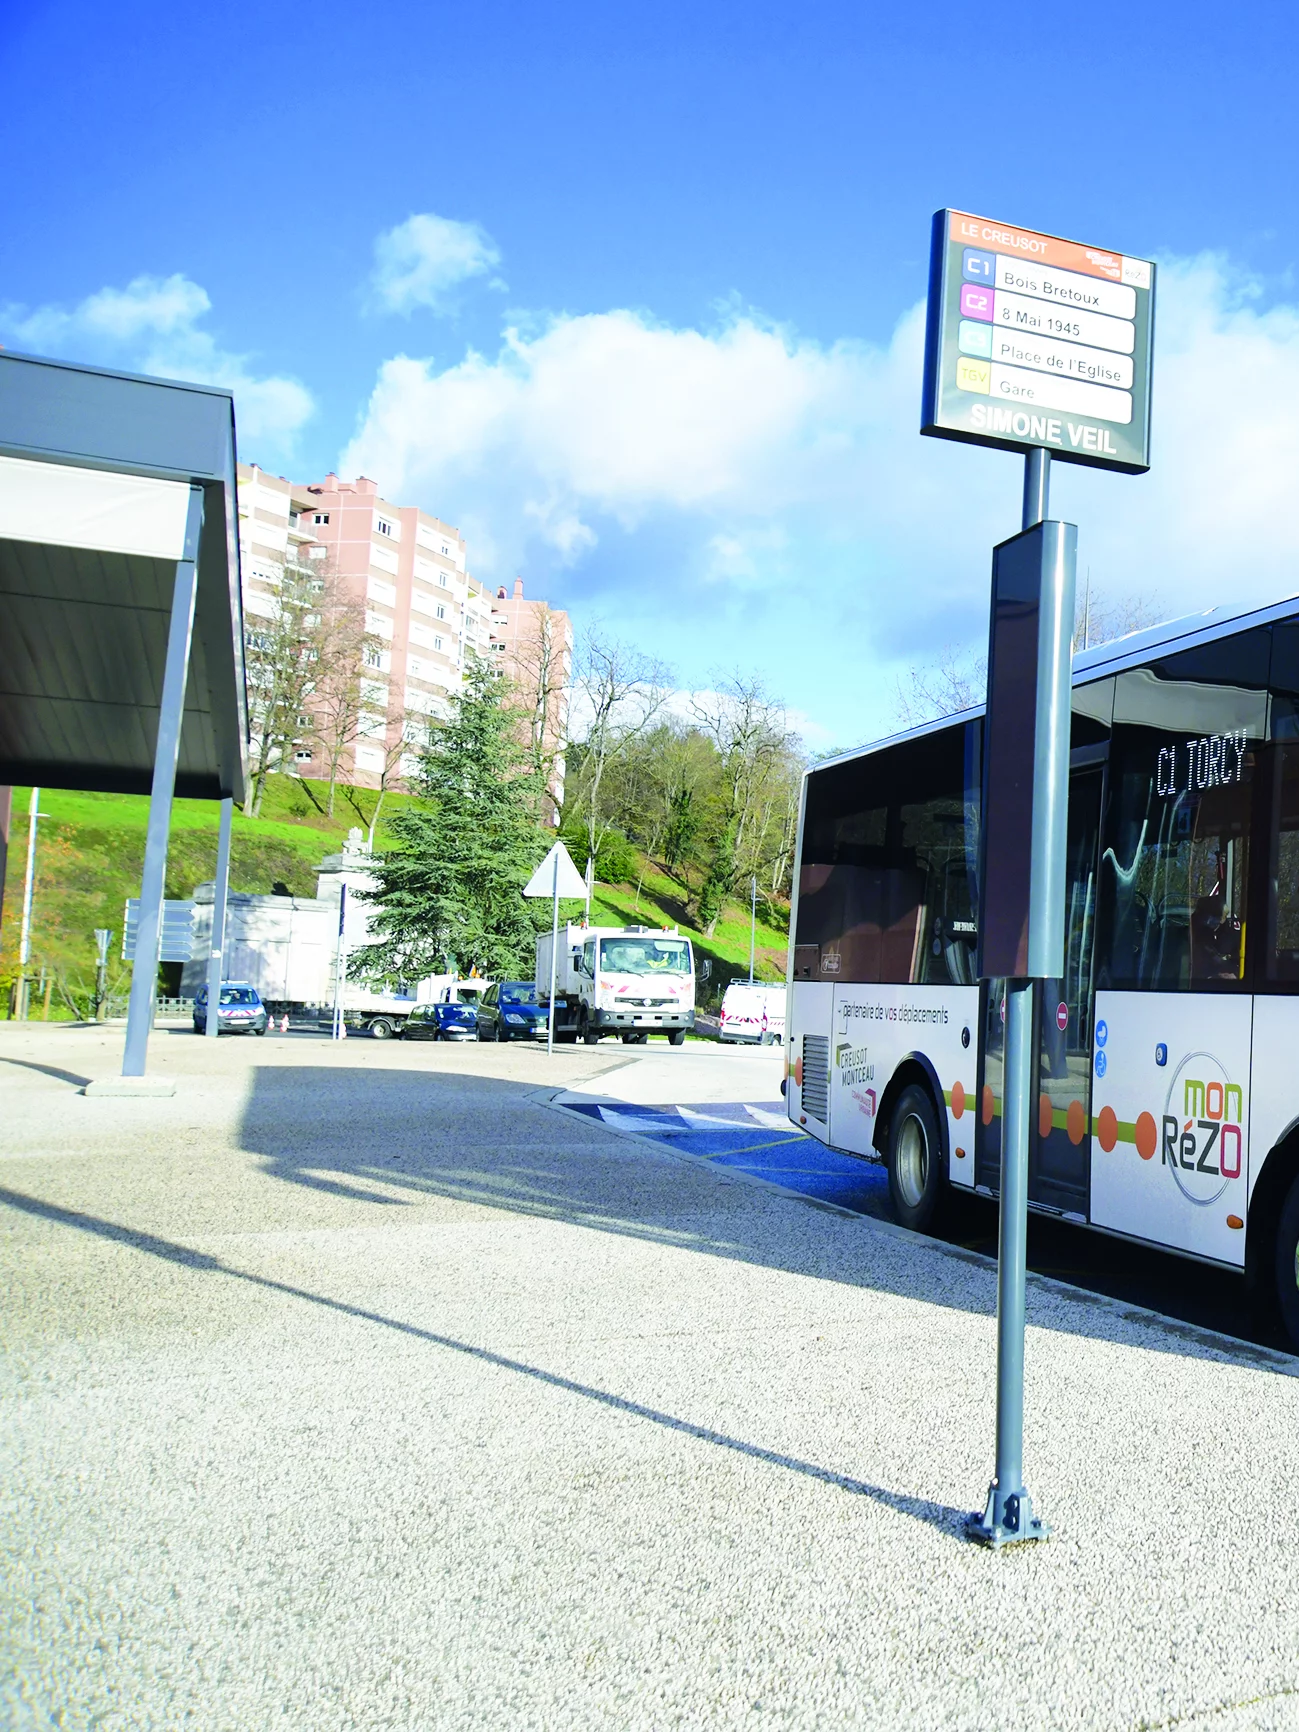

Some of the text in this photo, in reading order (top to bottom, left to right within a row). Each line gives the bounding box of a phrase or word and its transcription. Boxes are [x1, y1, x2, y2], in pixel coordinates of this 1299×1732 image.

[961, 222, 1048, 254] LE CREUSOT
[967, 257, 990, 276] C1
[1004, 272, 1100, 306] Bois Bretoux
[965, 293, 988, 312] C2
[1002, 307, 1080, 336] 8 Mai 1945
[1001, 343, 1042, 364] Place
[1046, 355, 1064, 369] de
[961, 367, 987, 383] TGV
[1000, 380, 1035, 399] Gare
[969, 403, 1117, 455] SIMONE VEIL
[1156, 728, 1247, 797] C1 TORCY
[843, 1002, 949, 1024] partenaire de vos déplacements
[840, 1047, 868, 1069] CREUSOT
[841, 1064, 875, 1087] MONTCEAU
[1184, 1079, 1243, 1124] mon
[1162, 1114, 1242, 1180] RéZO
